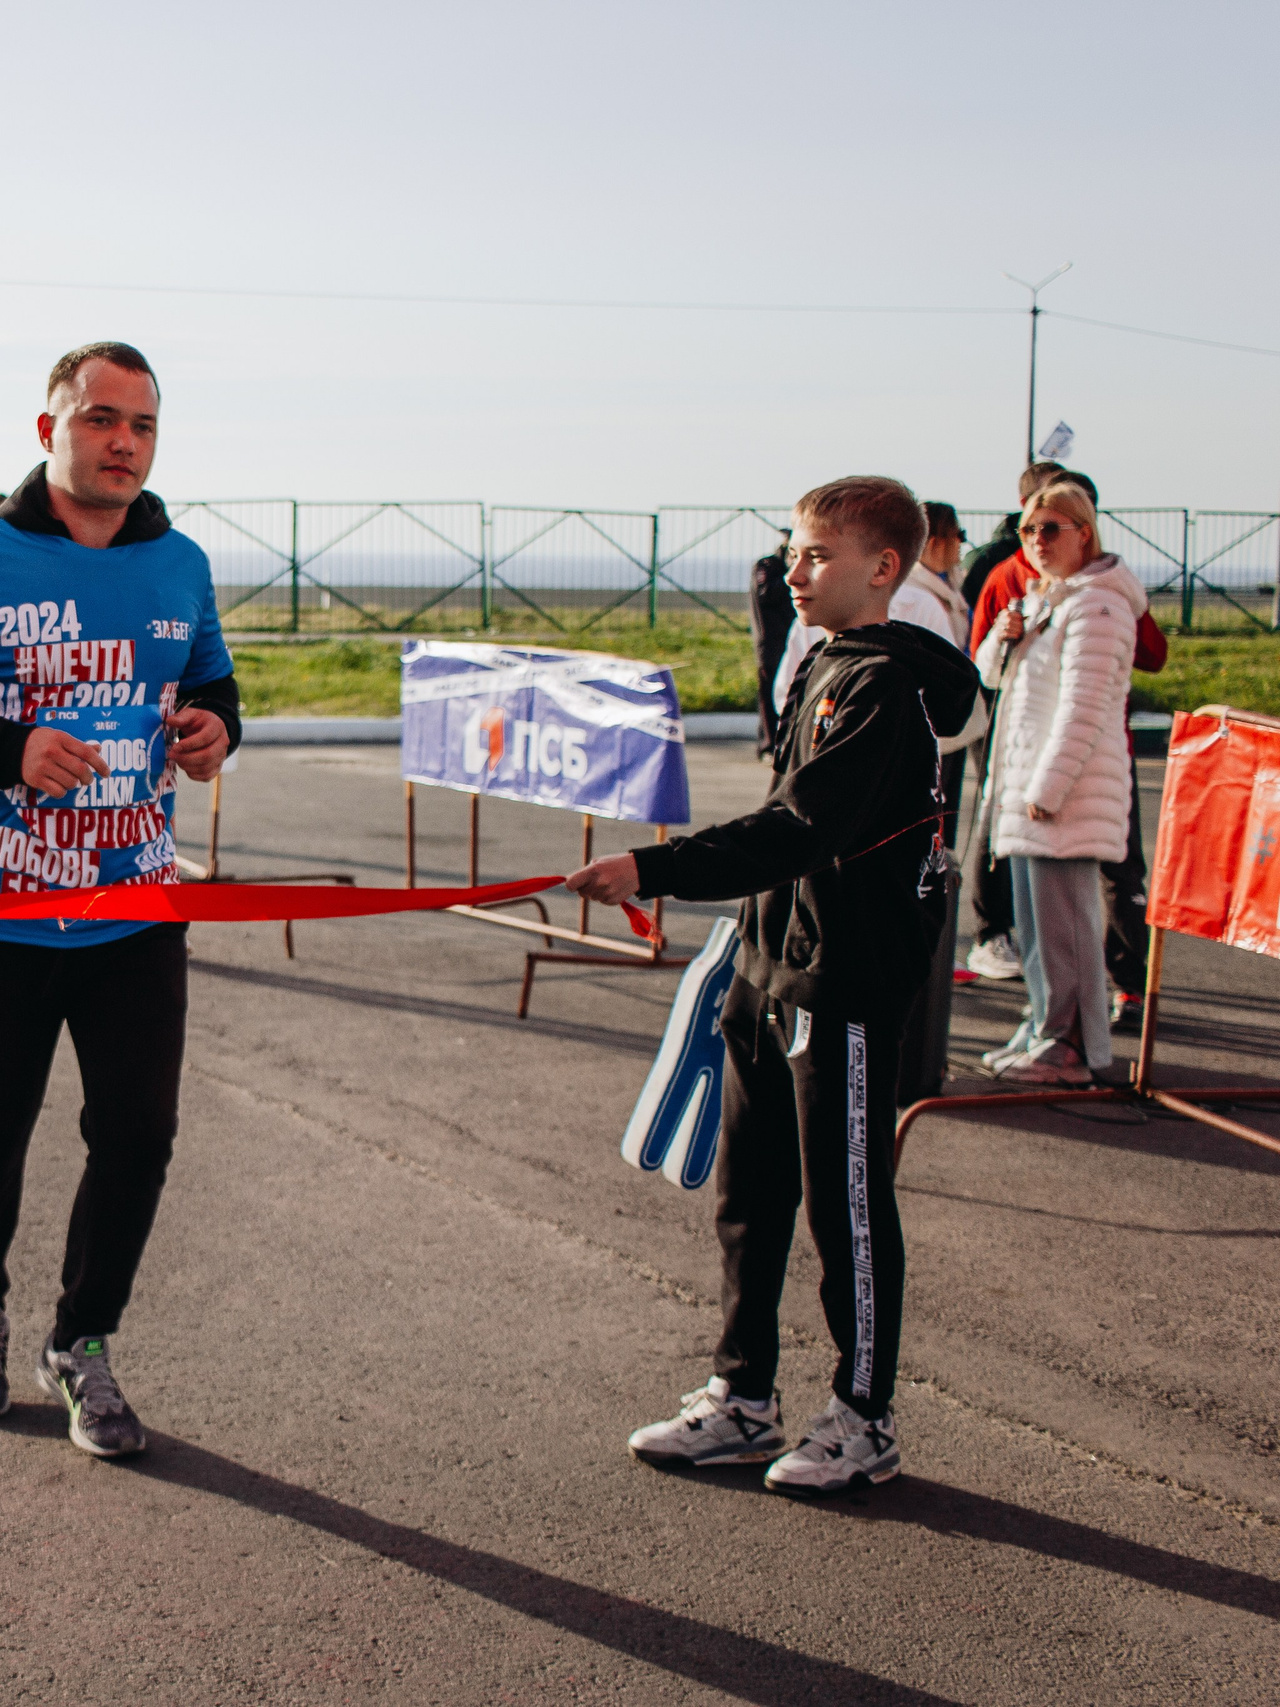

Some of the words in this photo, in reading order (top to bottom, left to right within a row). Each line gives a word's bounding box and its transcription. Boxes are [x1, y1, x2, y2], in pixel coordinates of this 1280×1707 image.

[15, 639, 134, 684] #МЕЧТА
[58, 711, 79, 720] ПСБ
[511, 719, 587, 780] ПСБ
[855, 1041, 864, 1066] OPEN
[854, 1159, 865, 1185] OPEN
[861, 1276, 871, 1300] OPEN
